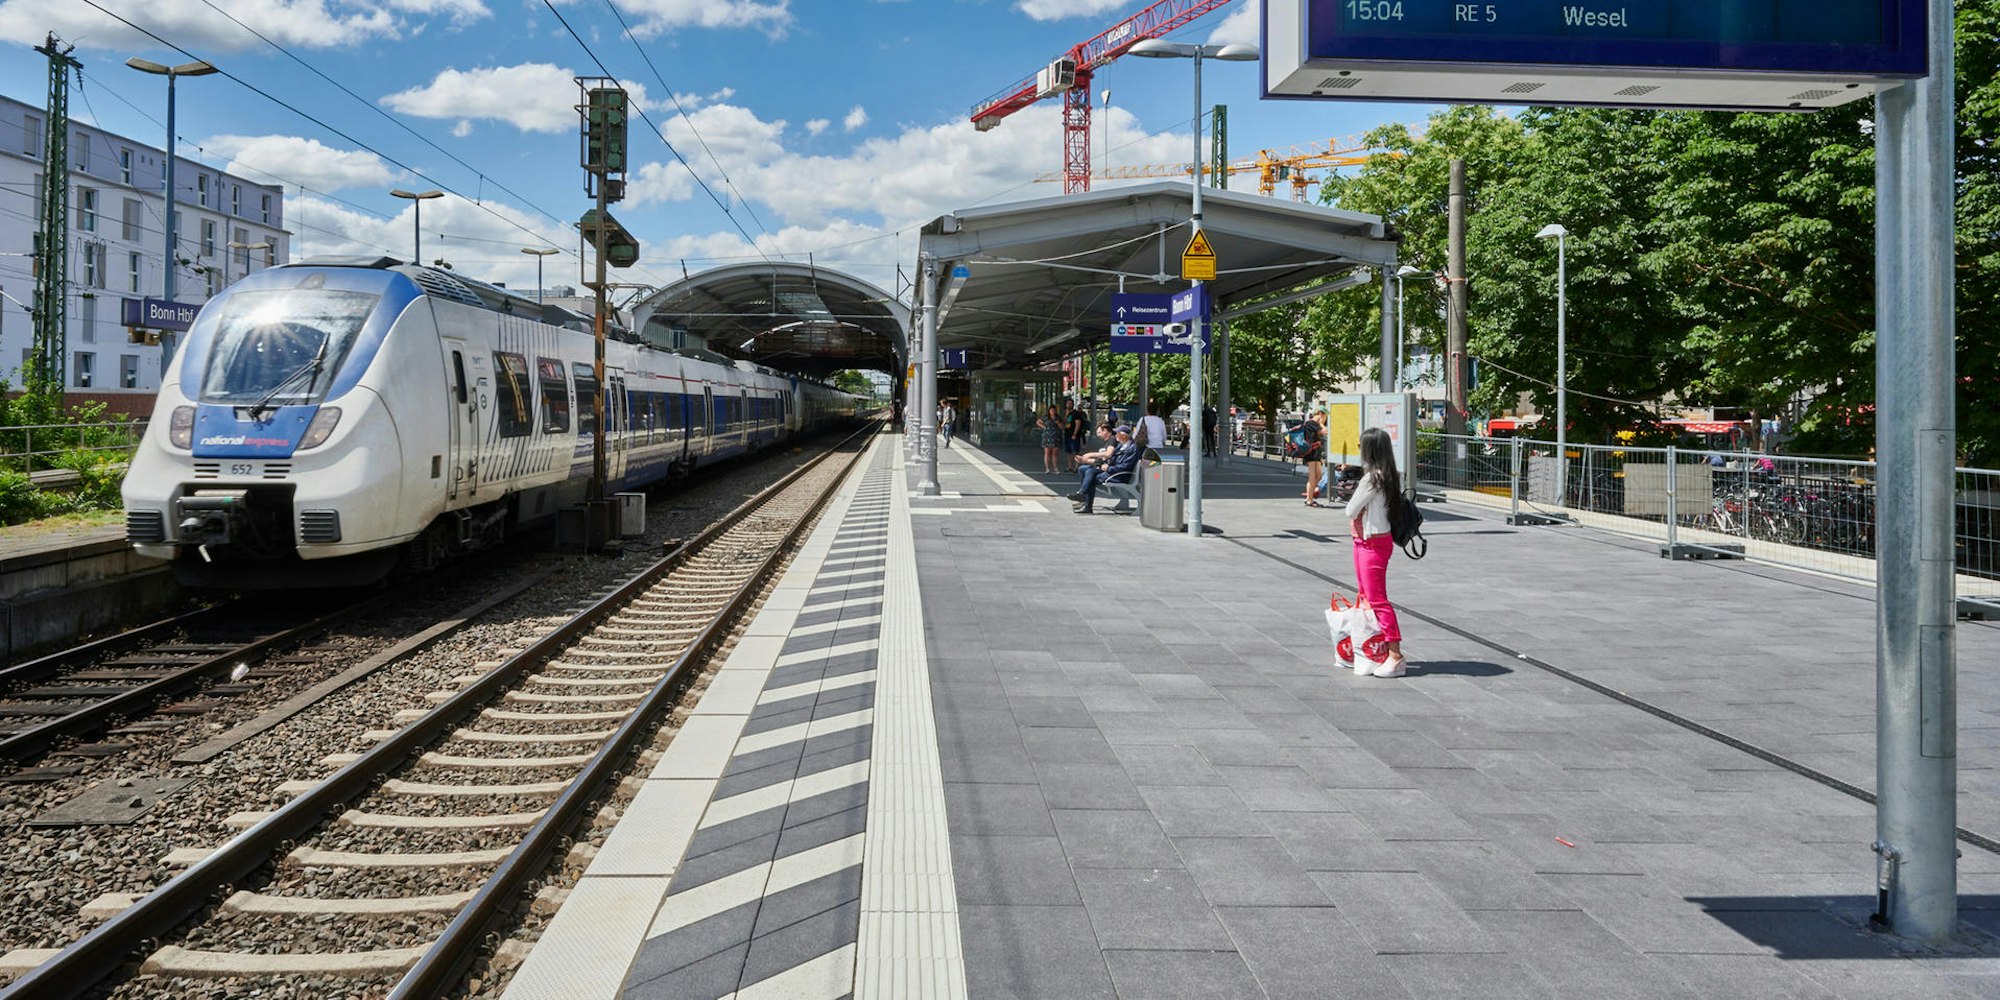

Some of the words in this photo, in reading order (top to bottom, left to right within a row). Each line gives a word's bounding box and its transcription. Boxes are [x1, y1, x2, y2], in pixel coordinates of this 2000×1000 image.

[1347, 1, 1404, 21] 15:04
[1455, 4, 1479, 22] RE
[1486, 5, 1497, 22] 5
[1563, 6, 1628, 27] Wesel
[150, 303, 175, 320] Bonn
[177, 306, 194, 323] Hbf
[959, 350, 966, 364] 1
[200, 435, 246, 445] national
[245, 437, 289, 448] express
[231, 464, 253, 475] 652
